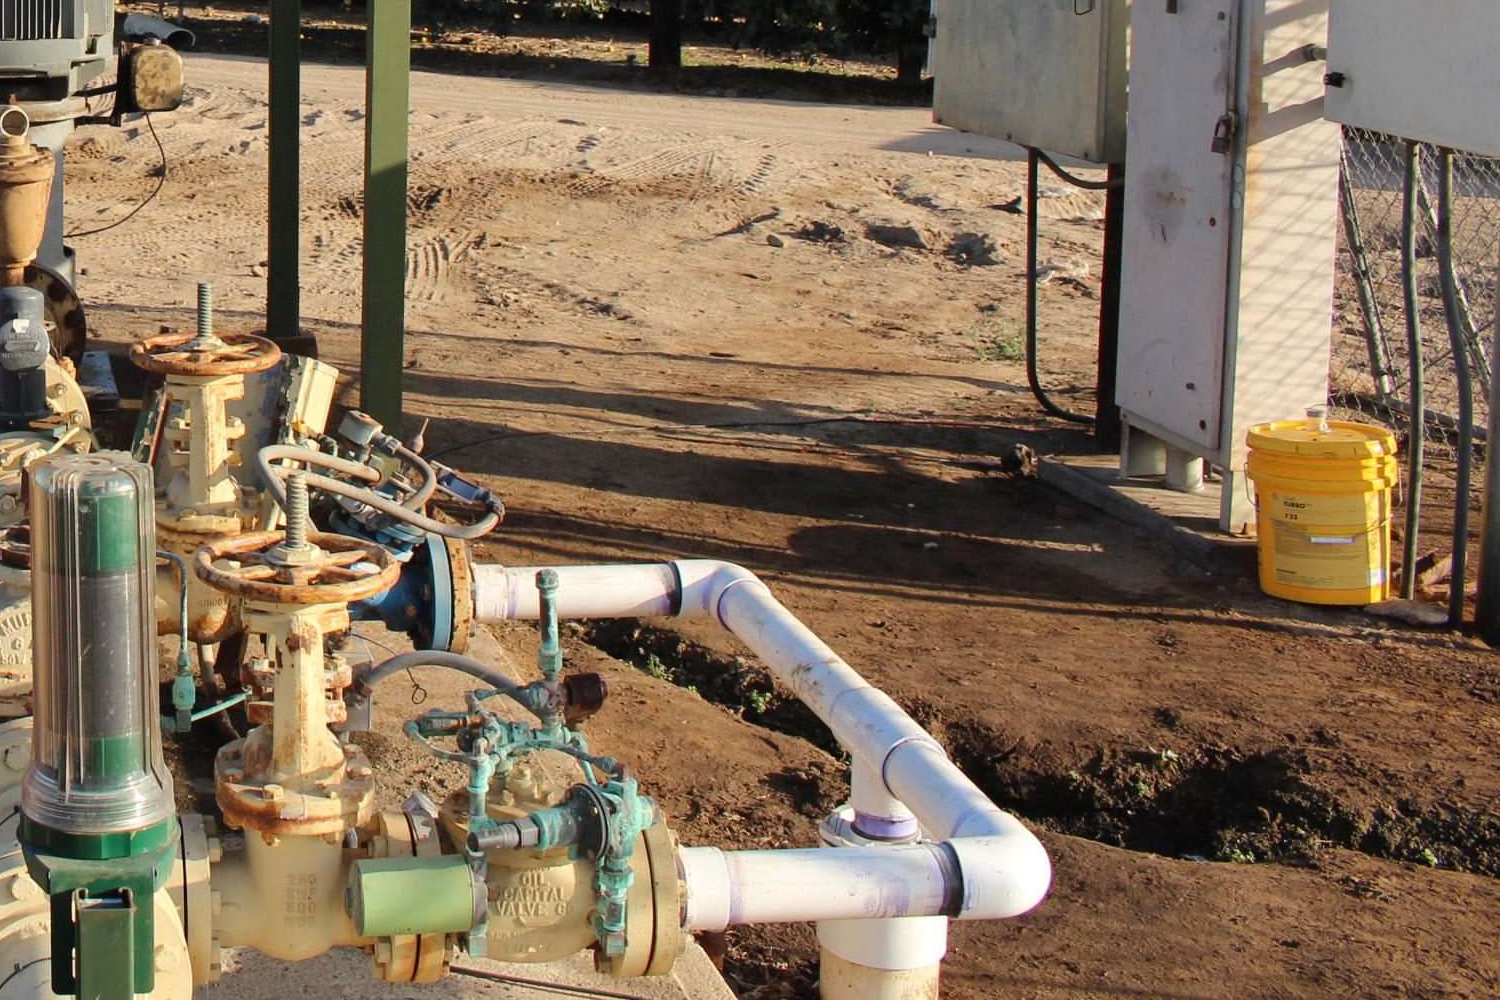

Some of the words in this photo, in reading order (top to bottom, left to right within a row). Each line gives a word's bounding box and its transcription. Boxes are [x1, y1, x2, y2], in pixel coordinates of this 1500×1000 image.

[1284, 501, 1306, 509] TURBO
[520, 871, 550, 886] OIL
[503, 887, 570, 901] CAPITAL
[496, 901, 549, 916] VALVE
